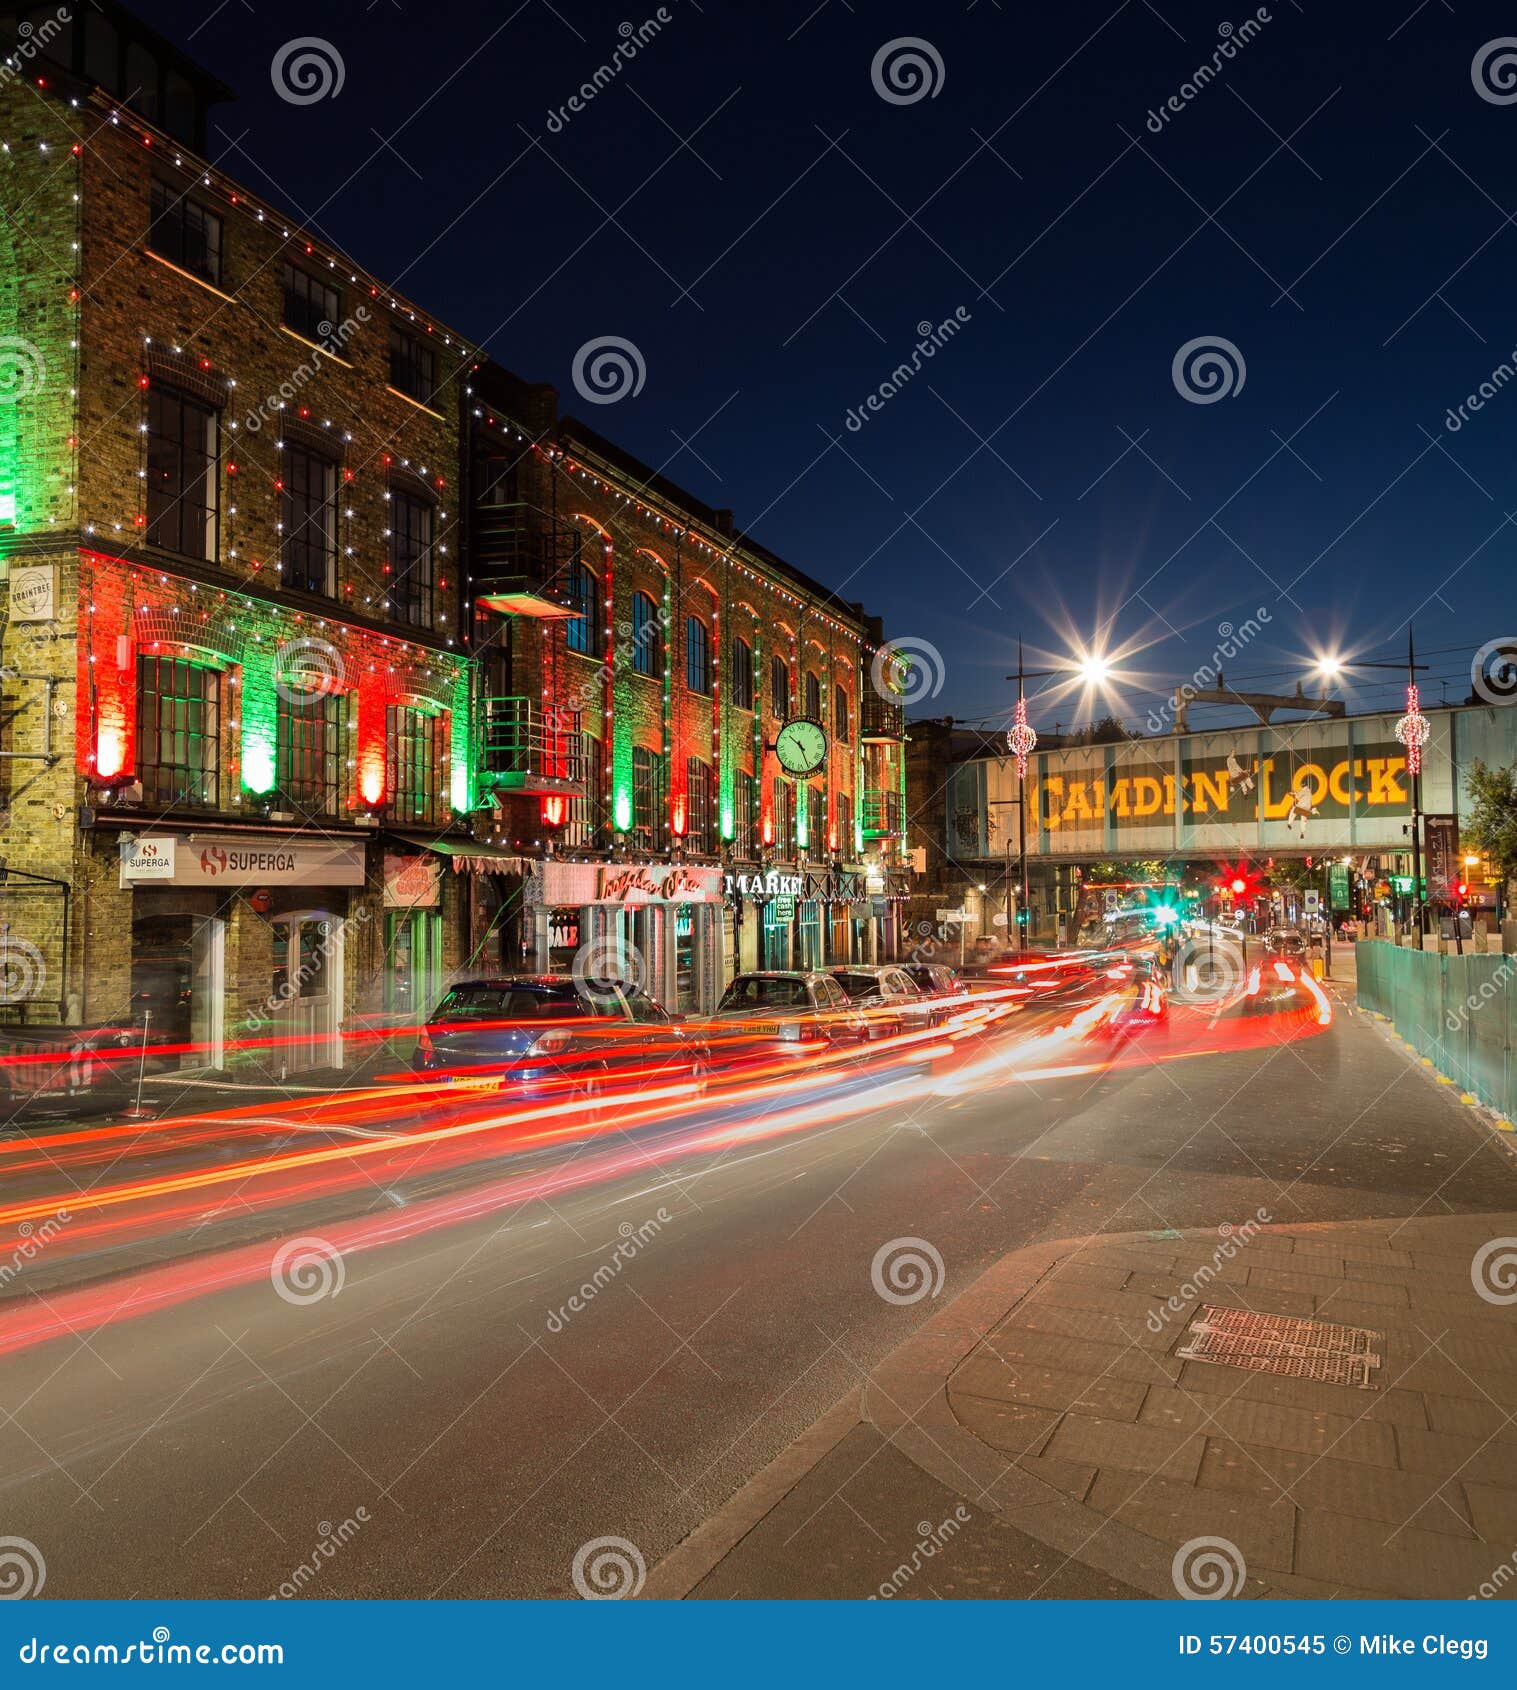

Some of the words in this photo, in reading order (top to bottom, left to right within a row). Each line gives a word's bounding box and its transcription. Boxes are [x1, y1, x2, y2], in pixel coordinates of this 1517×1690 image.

[1031, 770, 1229, 830] CAMDEN
[1254, 756, 1408, 819] LOCK
[129, 858, 170, 868] SUPERGA
[229, 853, 295, 871] SUPERGA
[725, 875, 803, 895] MARKET
